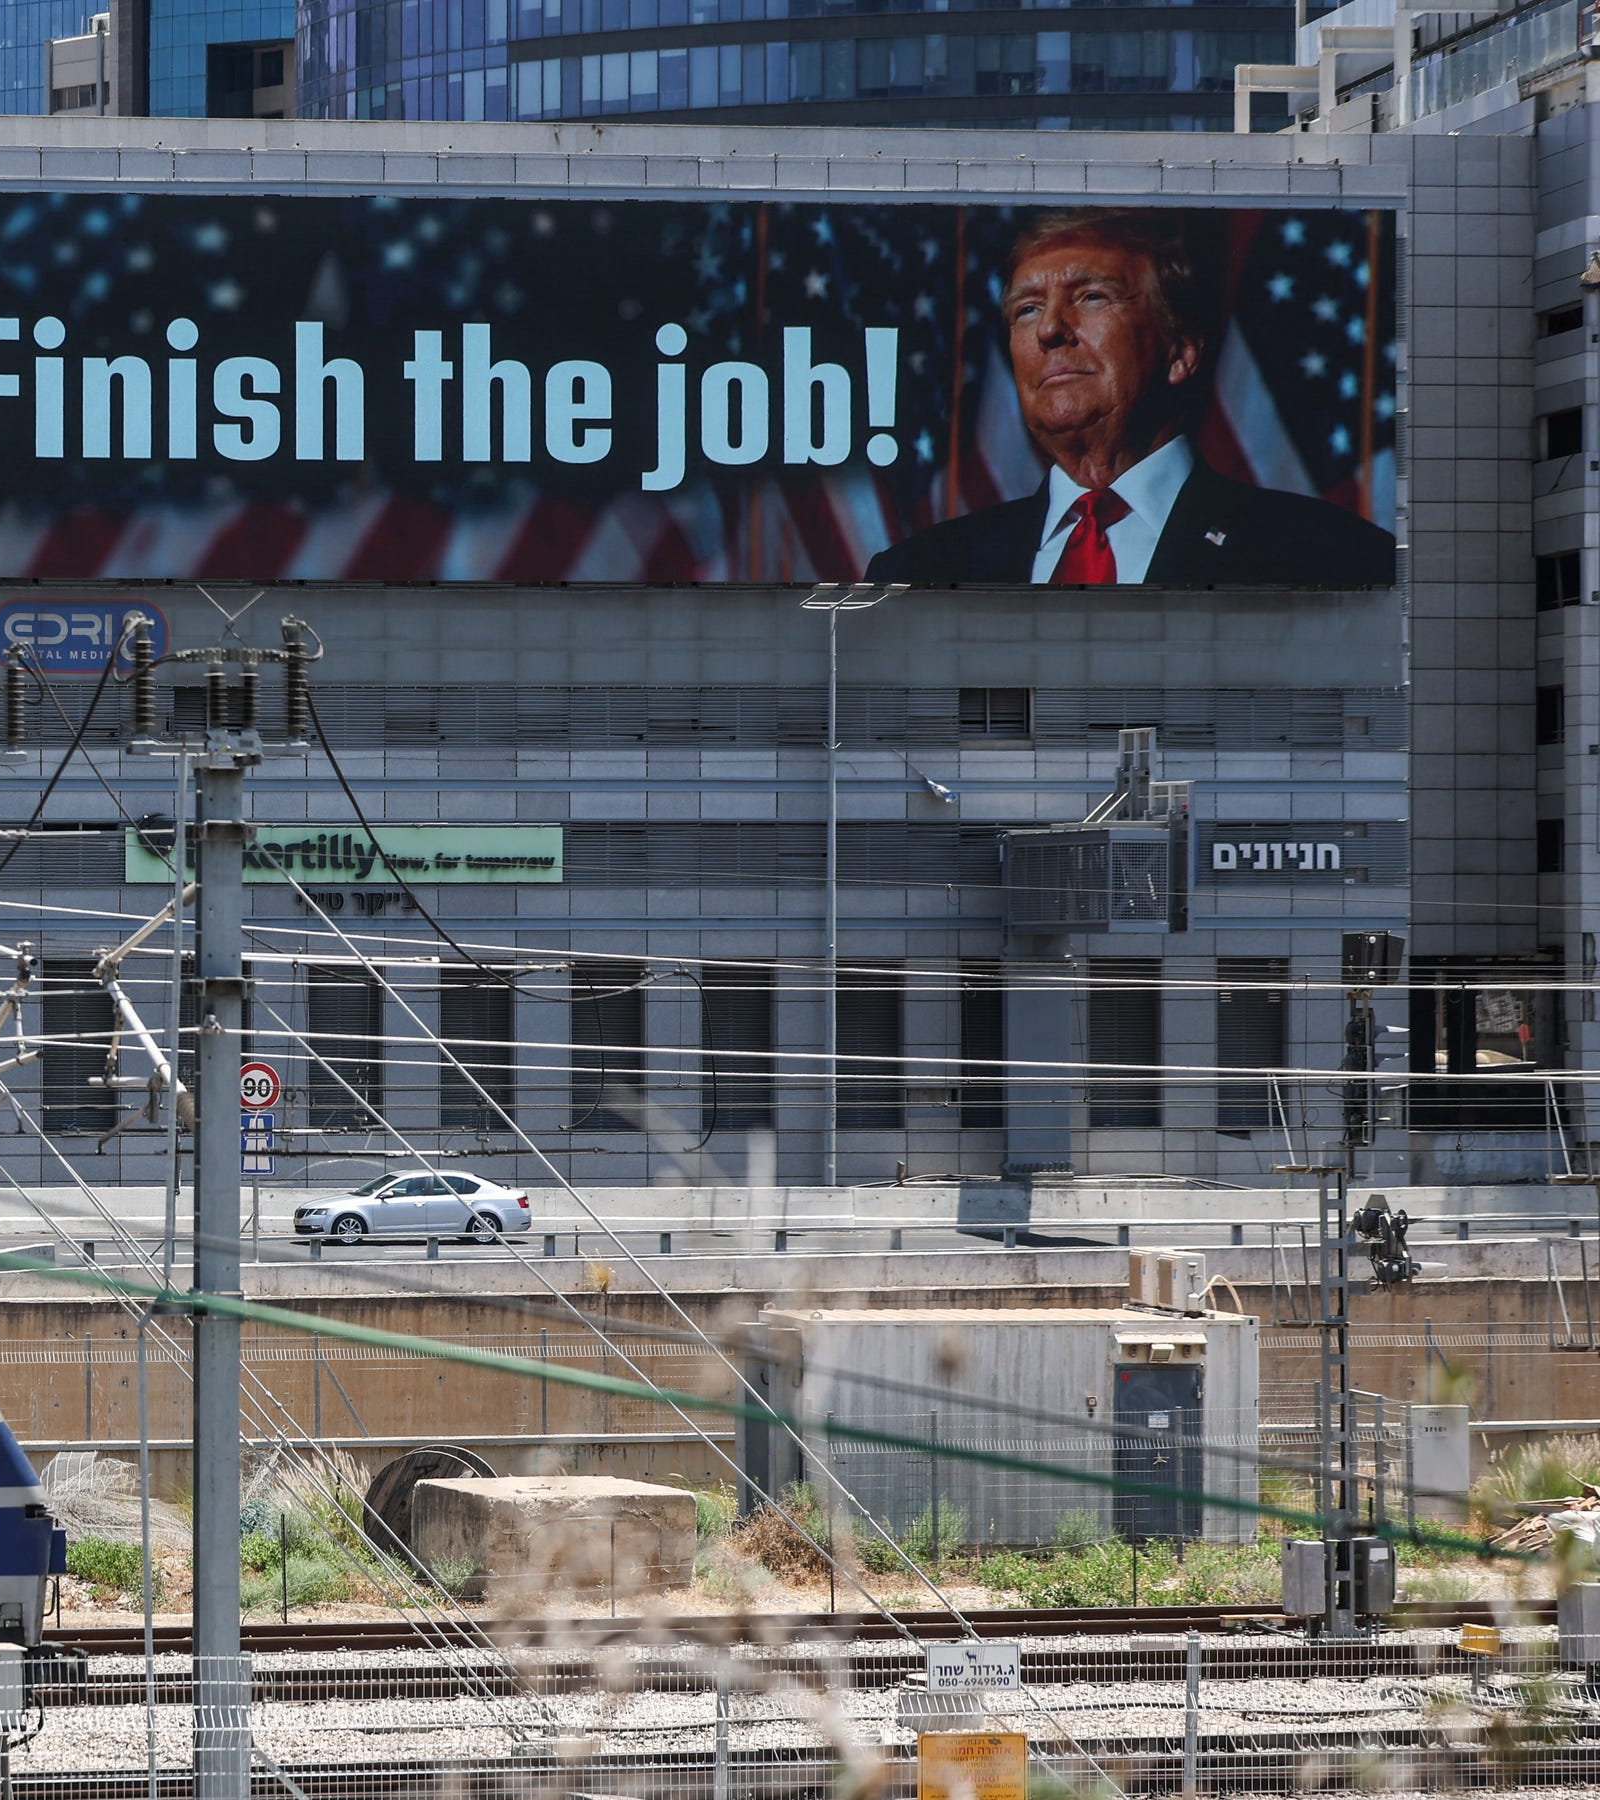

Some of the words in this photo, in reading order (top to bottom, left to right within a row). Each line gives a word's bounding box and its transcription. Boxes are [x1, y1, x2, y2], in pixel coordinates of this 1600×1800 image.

[403, 322, 613, 464] the
[641, 322, 900, 491] job!
[433, 852, 462, 869] for
[465, 854, 556, 869] tomorrow
[1212, 842, 1340, 870] חניונים
[243, 1077, 271, 1098] 90
[935, 1664, 964, 1677] שחר
[969, 1664, 1016, 1676] ג.גידור
[938, 1676, 1010, 1687] 050-6949590
